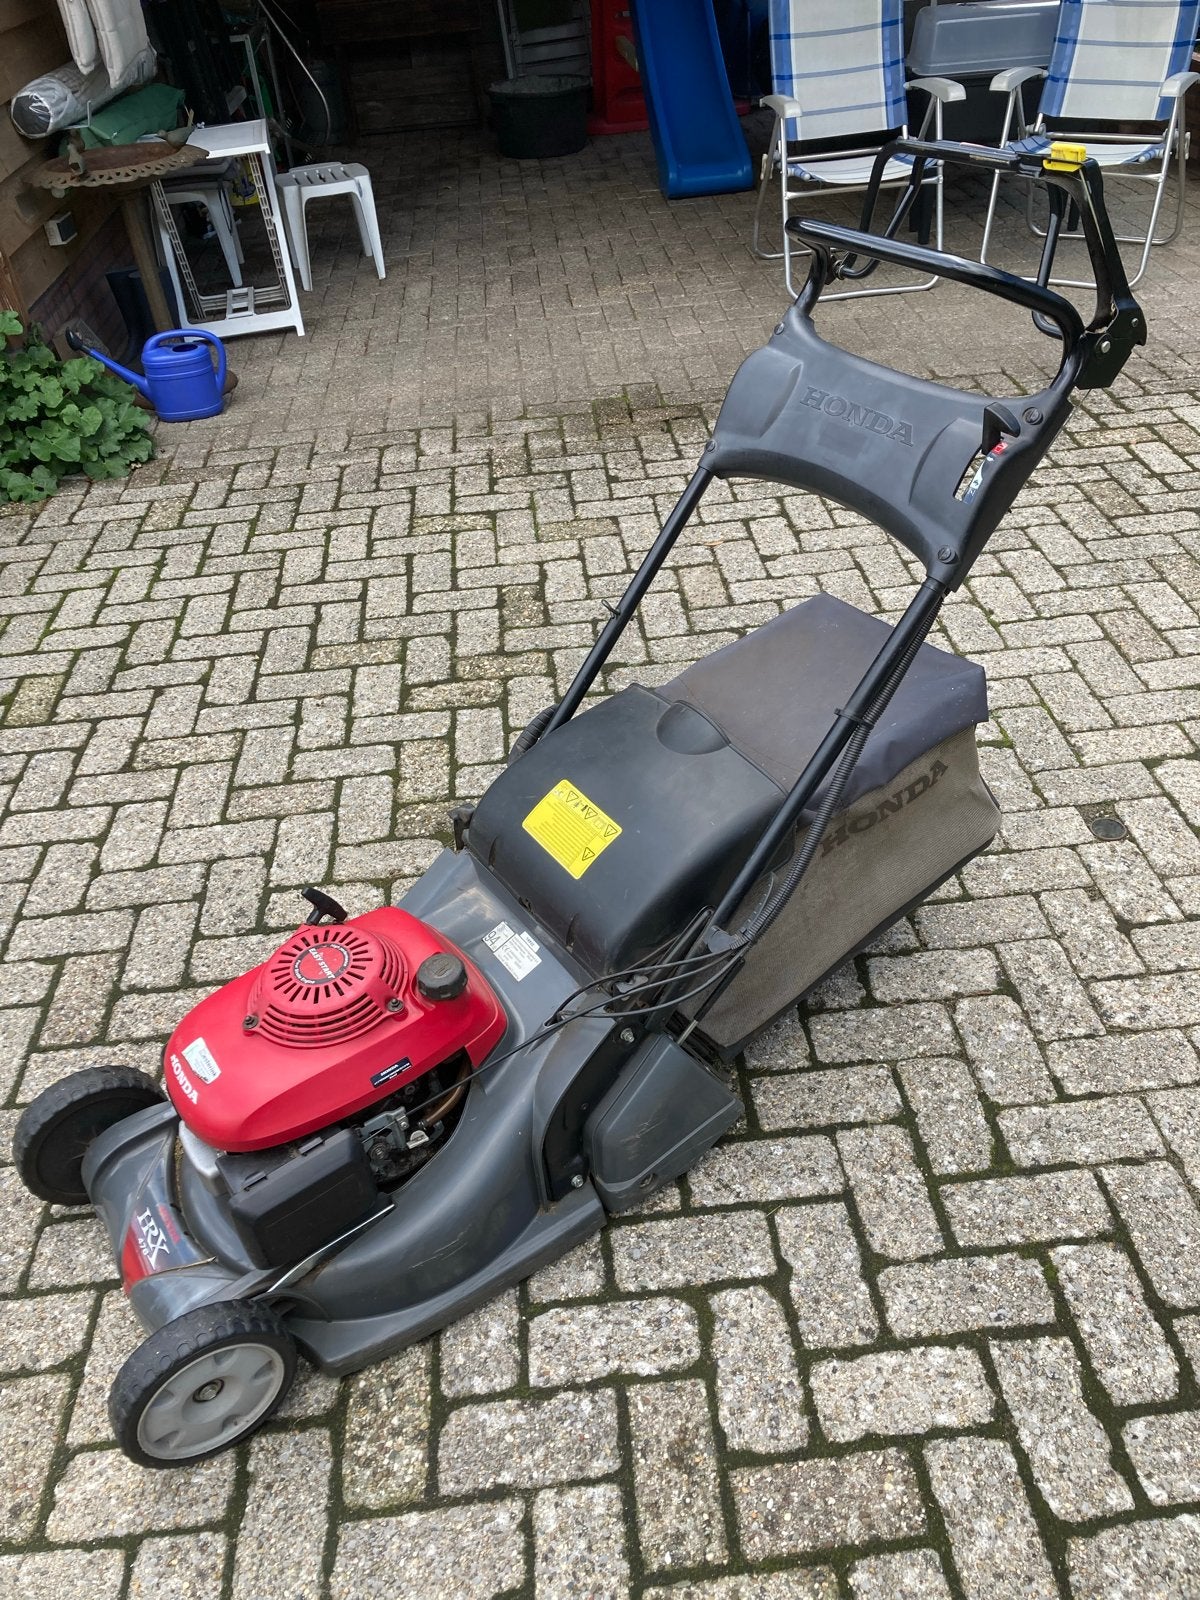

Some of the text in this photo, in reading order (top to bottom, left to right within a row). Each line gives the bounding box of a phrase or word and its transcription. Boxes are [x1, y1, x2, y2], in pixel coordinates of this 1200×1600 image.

[799, 385, 915, 448] HONDA
[820, 759, 949, 858] HONDA
[309, 948, 336, 979] EASY START
[485, 931, 501, 946] 94
[170, 1054, 199, 1105] HONDA
[380, 1064, 399, 1077] HONDA
[137, 1206, 170, 1270] HRX
